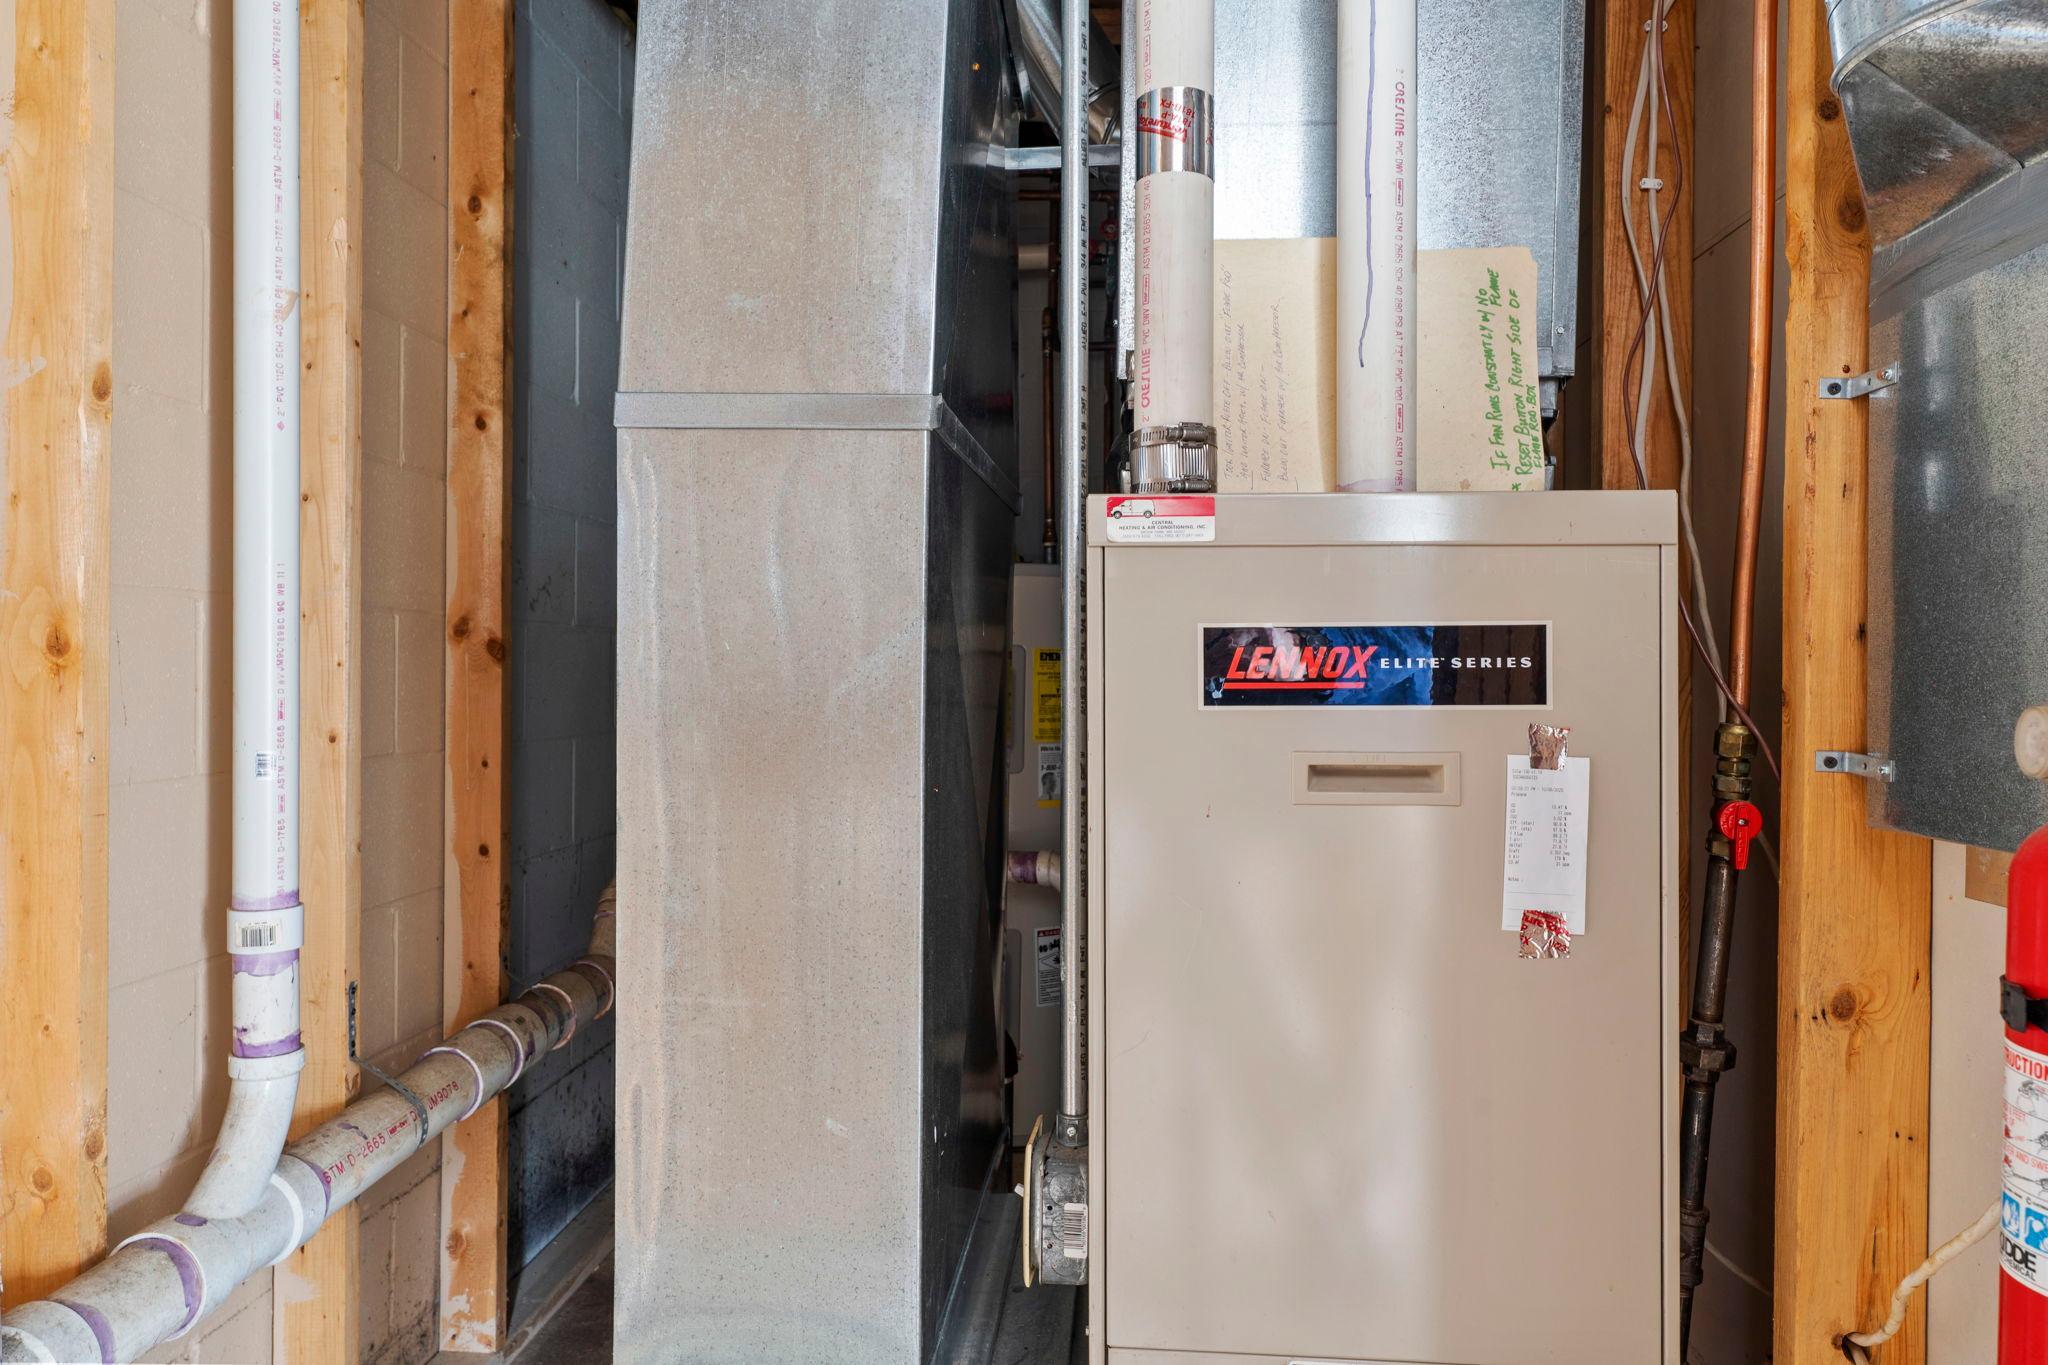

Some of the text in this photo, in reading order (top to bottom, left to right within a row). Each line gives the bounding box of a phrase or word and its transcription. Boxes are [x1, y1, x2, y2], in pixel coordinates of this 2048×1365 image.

[1395, 82, 1404, 137] CRESLINE
[1395, 141, 1404, 156] PVC
[274, 166, 283, 190] ASTM
[1142, 180, 1151, 191] 40
[1142, 194, 1151, 211] SCH
[1142, 213, 1151, 235] 2665
[1395, 211, 1404, 233] ASTM
[1142, 246, 1151, 269] ASTM
[1395, 243, 1404, 263] 2665
[274, 257, 283, 281] ASTM
[1395, 285, 1404, 295] 40
[1475, 288, 1488, 306] NO
[1487, 268, 1502, 306] FLAME
[1395, 298, 1404, 312] 280
[1142, 309, 1151, 325] DWV
[1142, 329, 1151, 345] PVC
[1479, 325, 1500, 391] CONSTANTLY
[1142, 348, 1151, 409] CRESLINE
[1395, 368, 1404, 382] PVC
[1506, 288, 1533, 475] RESET BUTTON RIGHT SIDE OF
[1526, 385, 1536, 406] BOX
[1485, 395, 1502, 421] RUNS
[1488, 424, 1504, 446] FAN
[1395, 436, 1404, 457] ASTM
[1490, 450, 1510, 471] IF
[1226, 646, 1378, 681] LENNOX
[1451, 657, 1533, 669] SERIES
